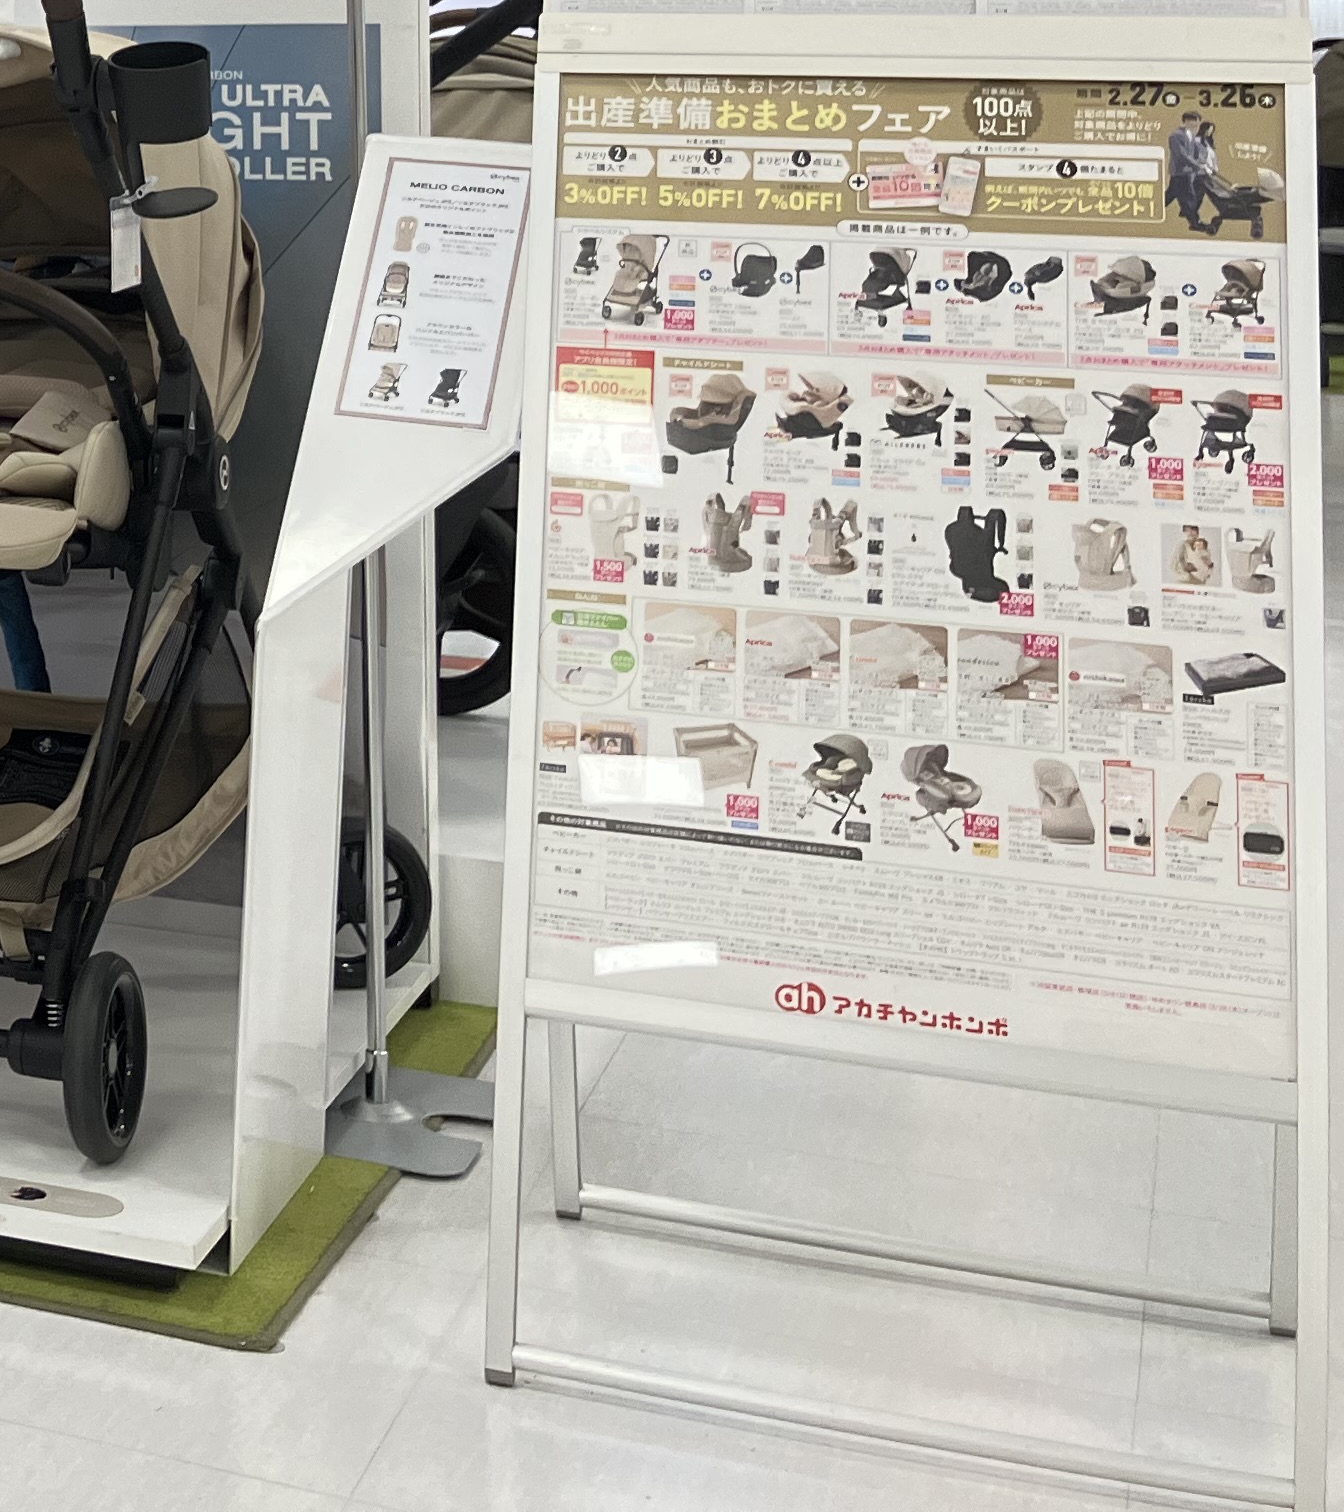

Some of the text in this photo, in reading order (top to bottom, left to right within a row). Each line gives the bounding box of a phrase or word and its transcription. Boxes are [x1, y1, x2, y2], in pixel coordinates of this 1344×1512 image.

[221, 83, 330, 108] ULTRA
[646, 76, 866, 97] 人気商品も、おトクに買える
[564, 95, 950, 133] 出産準備おまとめフェア
[972, 95, 1033, 119] 100点
[212, 110, 332, 151] GHT
[978, 118, 1027, 137] 以上!
[588, 162, 624, 173] ご購入で
[682, 165, 720, 176] ご購入で
[779, 168, 818, 179] ご購入で
[410, 182, 505, 195] MELIO CARBON
[564, 183, 842, 212] 3%OFF! 5%OFF! 7%OFF!
[987, 196, 1155, 217] クーポンプレゼント!
[850, 223, 958, 238] 掲載商品は一例です。
[832, 995, 1009, 1037] アカチャンホンポ
